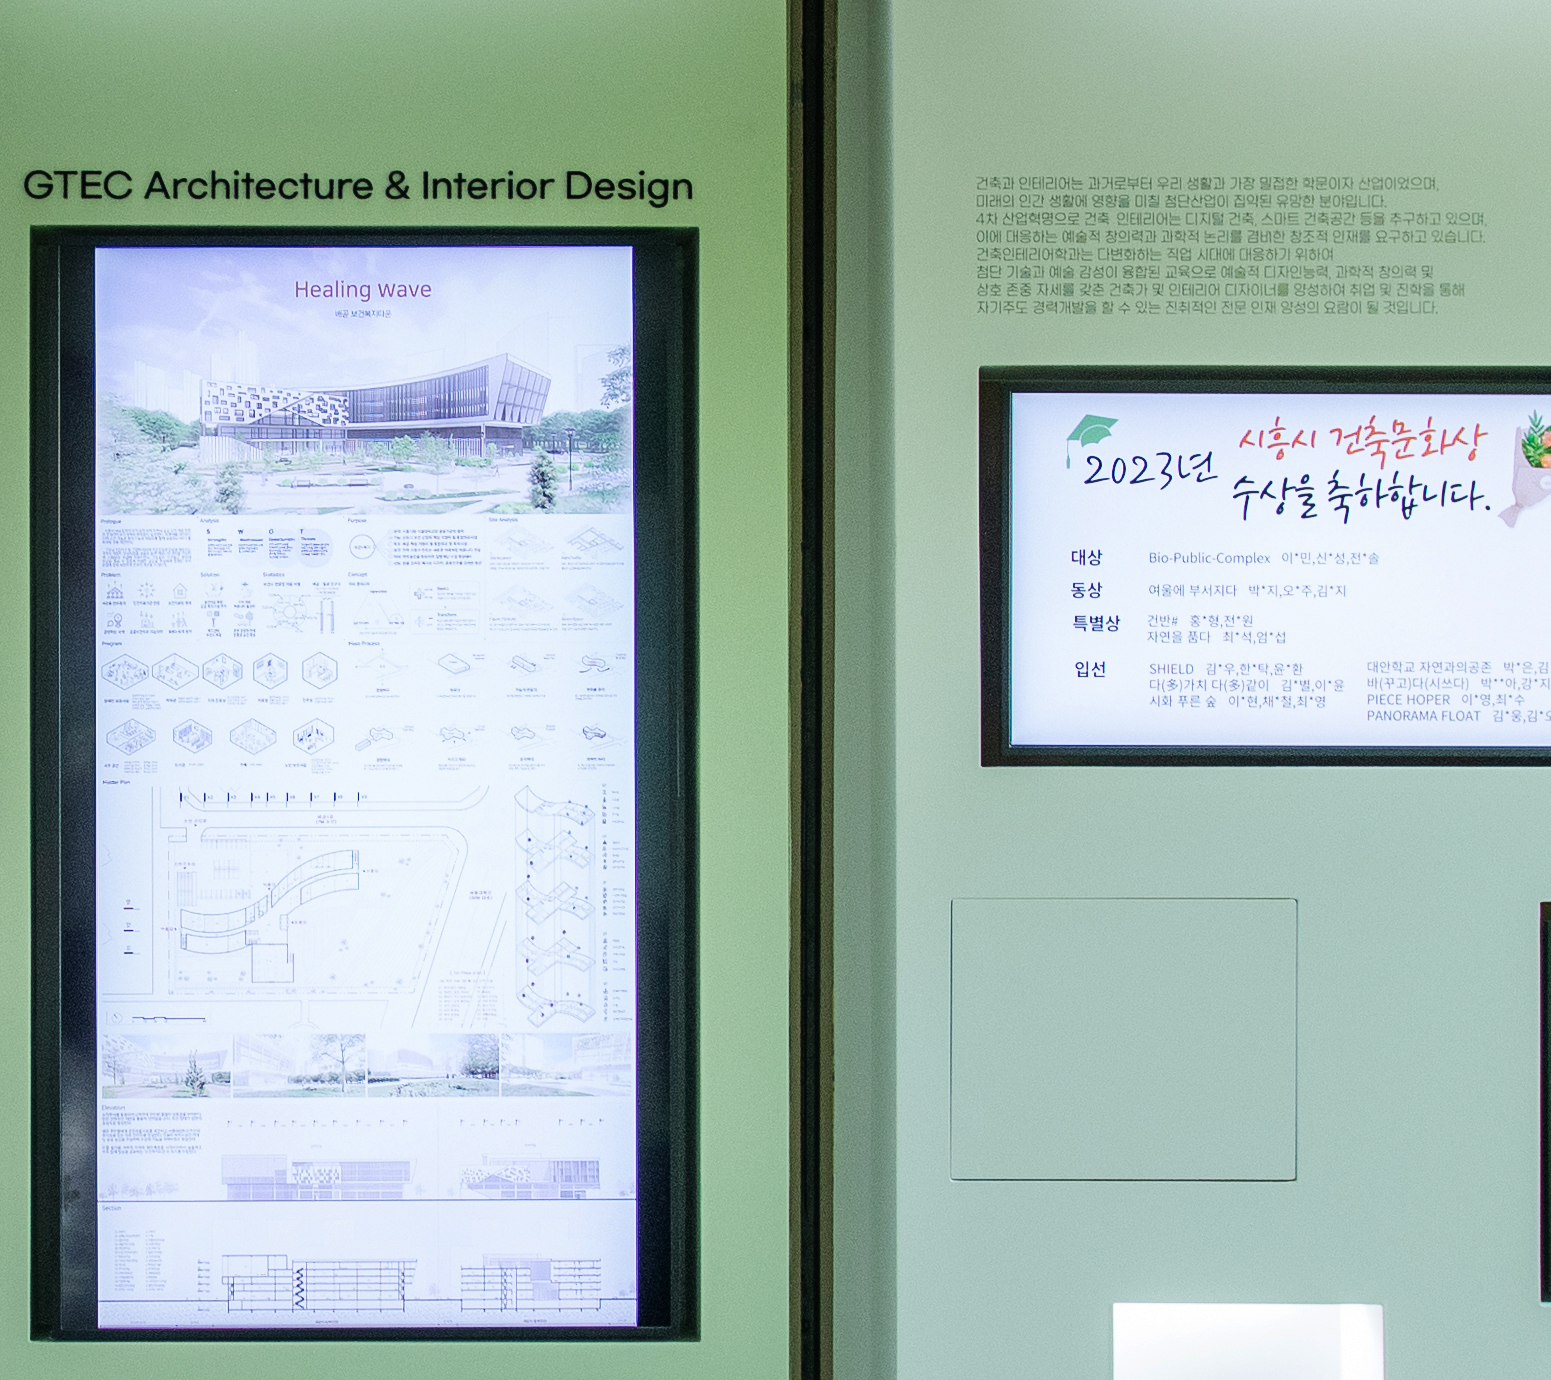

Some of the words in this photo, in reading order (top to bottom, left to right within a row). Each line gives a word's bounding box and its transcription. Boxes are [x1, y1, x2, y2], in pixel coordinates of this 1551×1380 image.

[24, 170, 132, 200] GTEC
[144, 170, 373, 200] Architecture
[385, 170, 409, 200] &
[423, 171, 555, 200] Interior
[566, 171, 693, 208] Design
[976, 176, 1015, 190] 건축과
[1018, 176, 1083, 190] 인테리어는
[1088, 176, 1152, 190] 과거로부터
[1157, 177, 1182, 190] 우리
[1187, 176, 1225, 191] 생활과
[1230, 176, 1255, 191] 가장
[1259, 176, 1298, 190] 밀접한
[1303, 176, 1354, 191] 학문이자
[1359, 177, 1439, 192] 산업이었으며,
[977, 247, 1093, 262] 건축인테리어학과는
[1097, 247, 1162, 262] 다변화하는
[1167, 247, 1192, 262] 직업
[1197, 247, 1235, 261] 시대에
[1239, 247, 1291, 262] 대응하기
[1295, 247, 1334, 261] 위하여
[295, 280, 371, 302] Healing
[378, 283, 432, 298] wave
[1239, 416, 1316, 460] 시흥시
[1329, 415, 1488, 469] 건축문화상
[1084, 452, 1218, 490] 2023년
[1233, 474, 1318, 521] 수상을
[1328, 470, 1491, 524] 축하합니다.
[1071, 549, 1103, 566] 대상
[1149, 552, 1271, 567] Bio-Public-Complex
[1071, 582, 1103, 599] 동상
[1148, 584, 1186, 598] 여울에
[1190, 584, 1238, 598] 부서지다
[1073, 615, 1121, 632] 특별상
[1147, 614, 1178, 628] 건반#
[1147, 631, 1183, 644] 자연을
[1188, 631, 1211, 644] 품다
[1075, 661, 1106, 678] 입선
[1149, 663, 1194, 675] SHIELD
[1367, 661, 1415, 674] 대안학교
[1420, 661, 1492, 674] 자연과의공존
[1149, 695, 1173, 708] 시화
[1178, 695, 1201, 708] 푸른
[1206, 695, 1217, 708] 숲
[1367, 694, 1403, 706] PIECE
[1407, 694, 1451, 706] HOPER
[1367, 710, 1438, 722] PANORAMA
[1442, 710, 1481, 722] FLOAT
